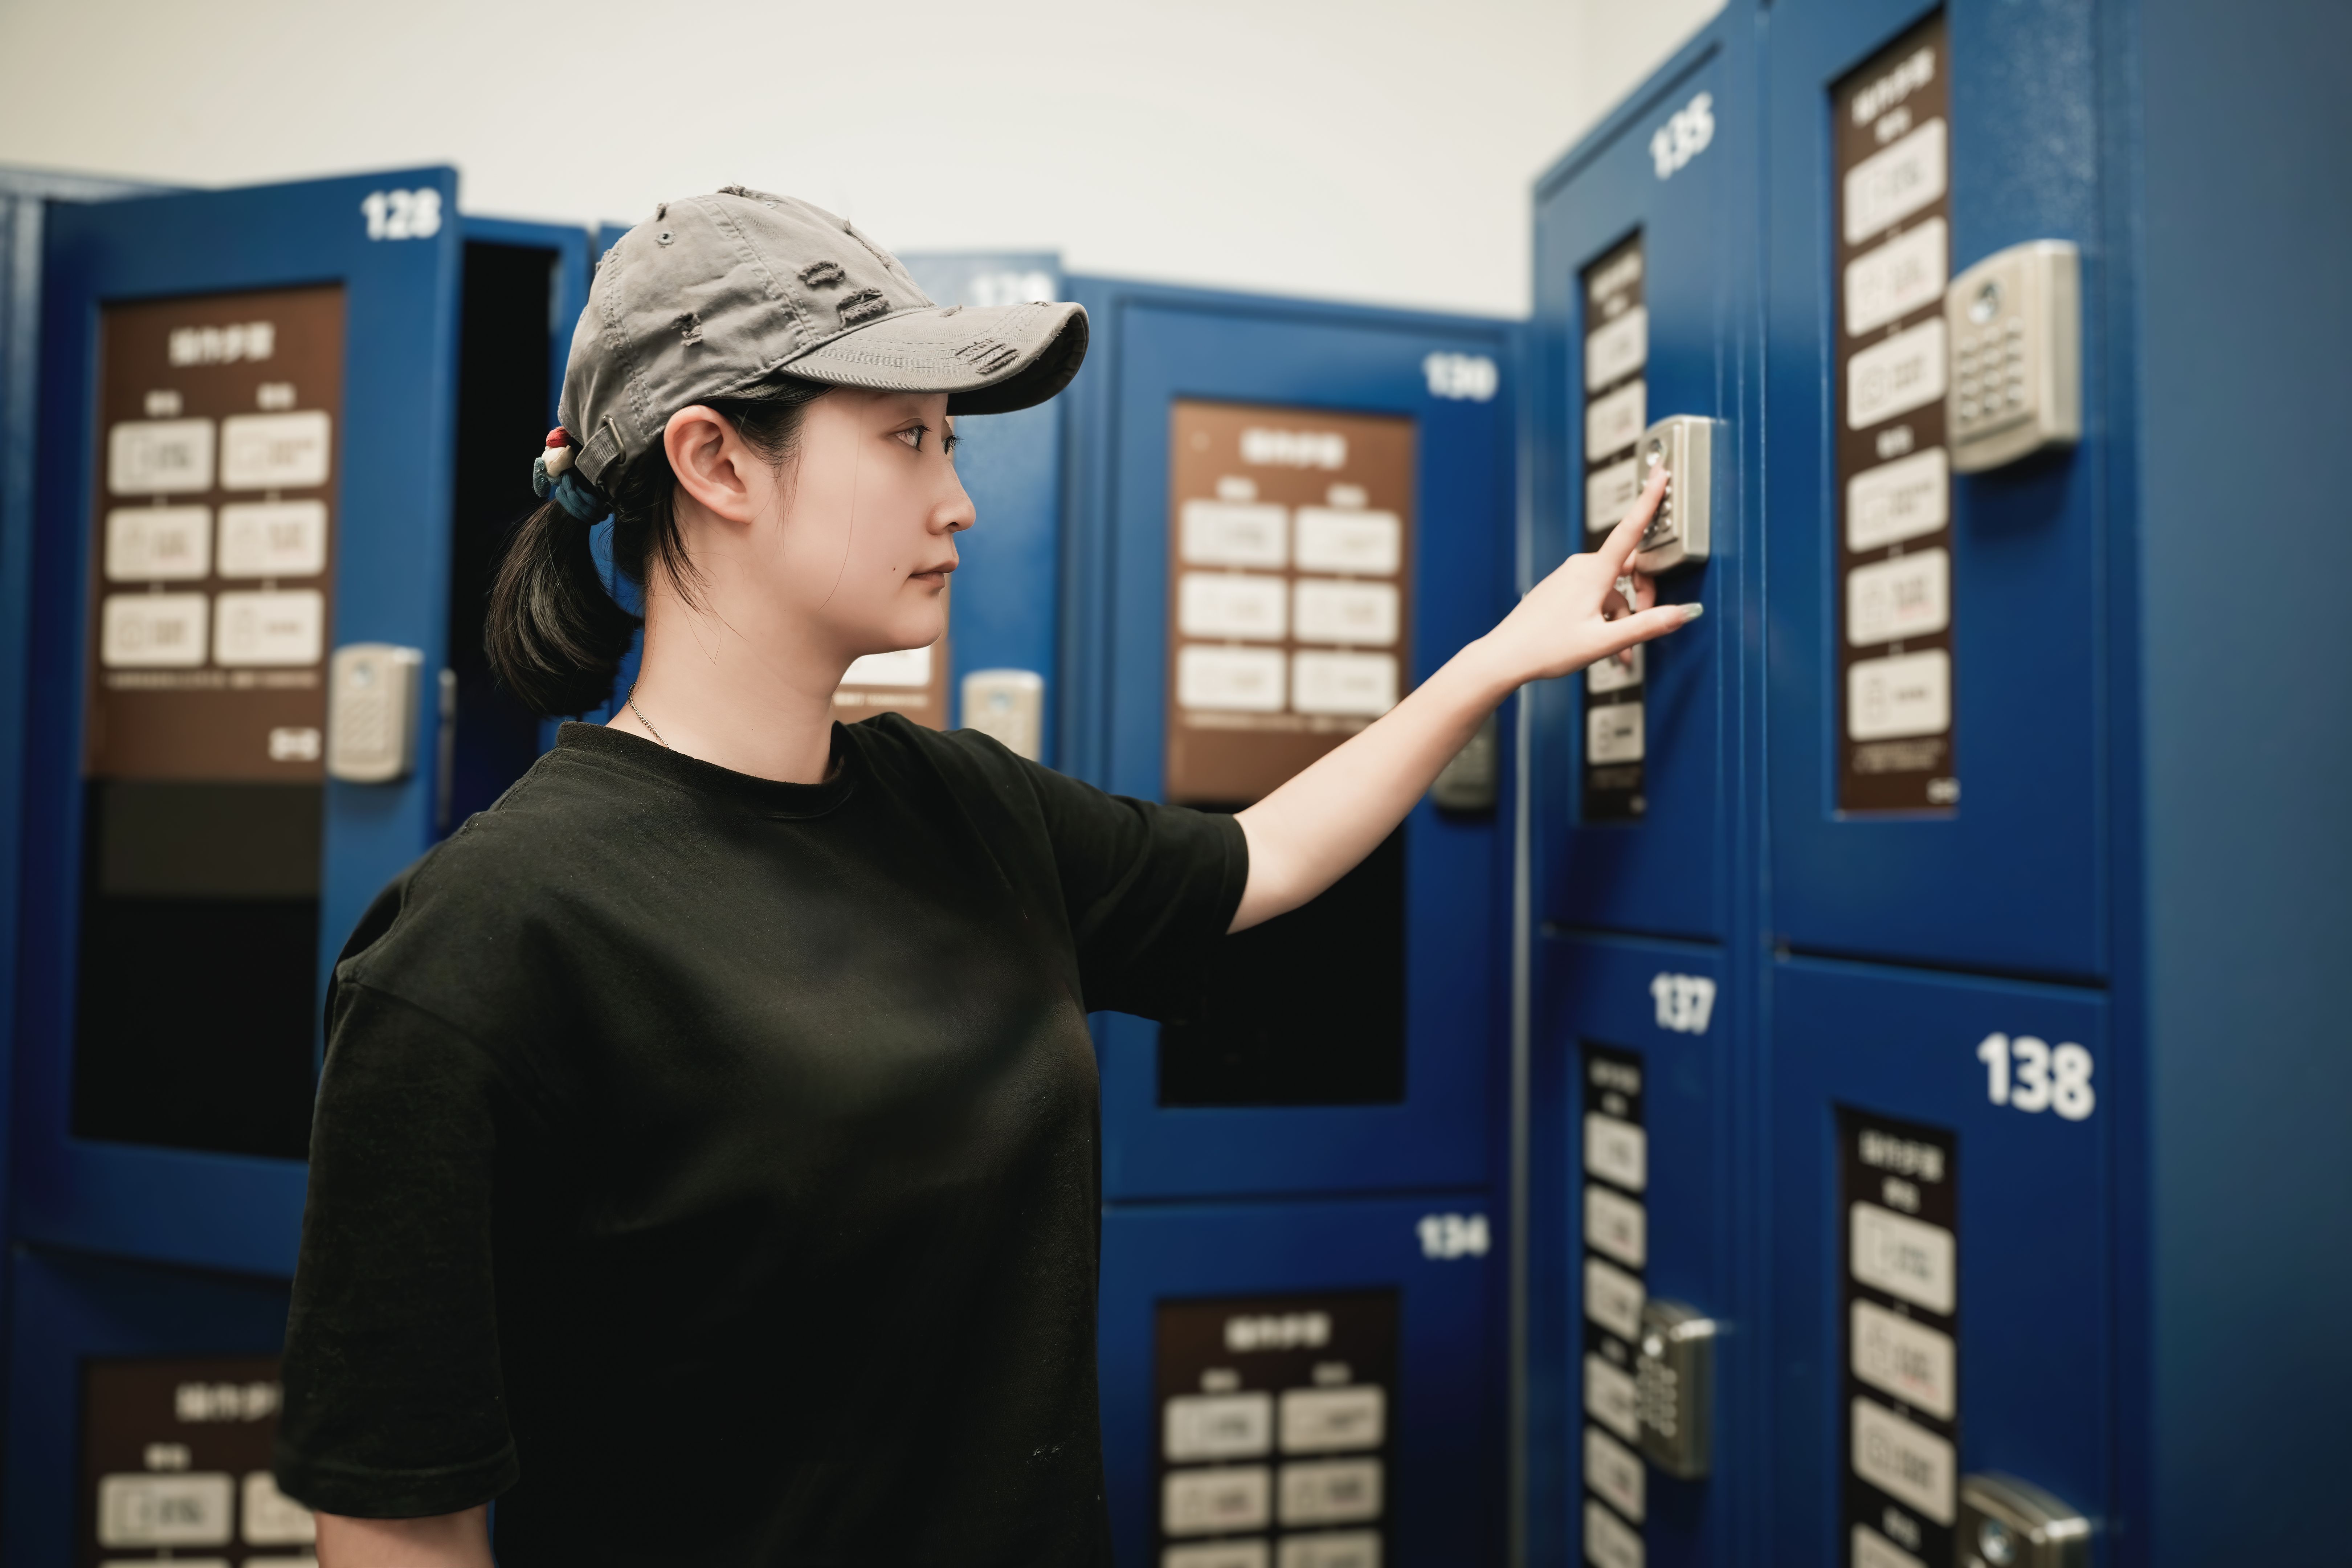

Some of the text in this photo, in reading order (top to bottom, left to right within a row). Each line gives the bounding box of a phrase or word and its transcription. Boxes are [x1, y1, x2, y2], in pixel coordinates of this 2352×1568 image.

[1649, 93, 1715, 179] 135
[361, 187, 442, 241] 128
[1422, 352, 1498, 401] 130
[1650, 974, 1716, 1033] 137
[1977, 1033, 2094, 1120] 138
